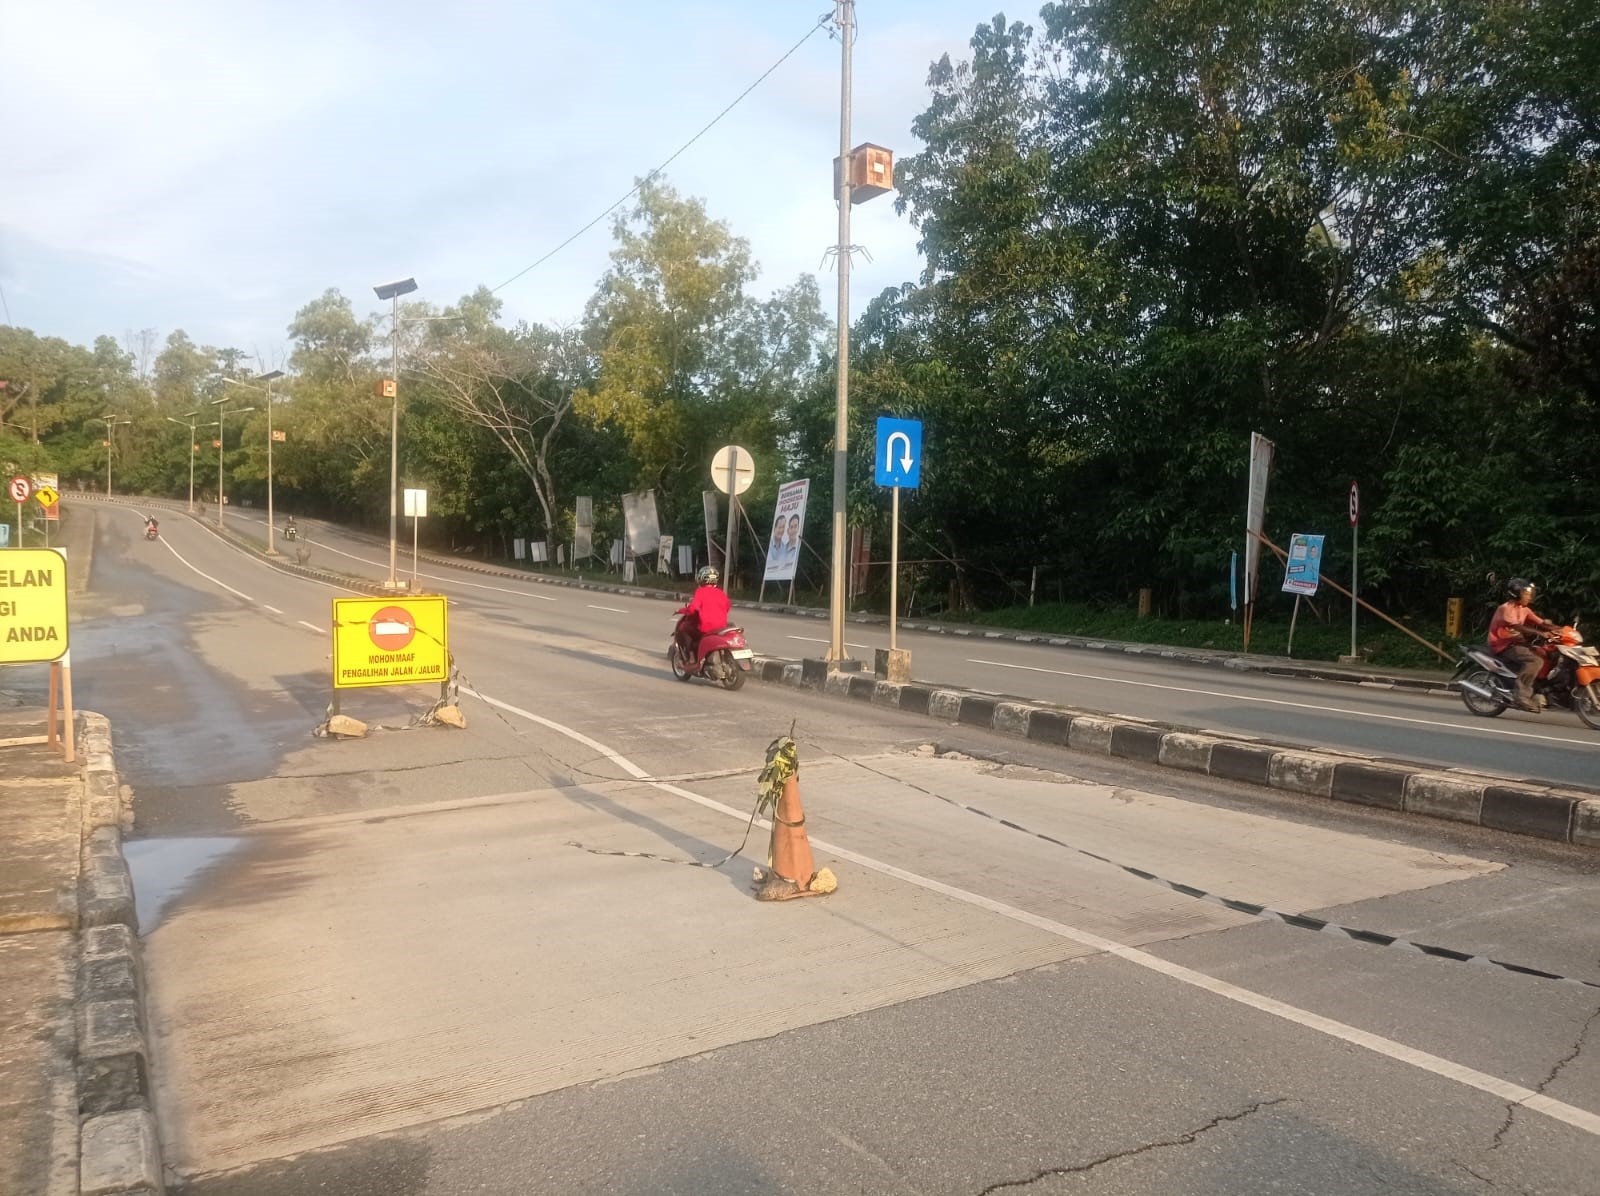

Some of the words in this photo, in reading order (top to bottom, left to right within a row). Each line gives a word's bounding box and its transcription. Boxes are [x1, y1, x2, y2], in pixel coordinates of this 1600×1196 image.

[0, 570, 52, 587] ELAN
[6, 626, 58, 642] ANDA
[369, 655, 395, 664] MOHON
[396, 653, 415, 662] MAAF
[342, 667, 388, 678] PENGALIHAN
[390, 666, 413, 676] JALAN
[418, 664, 440, 674] JALUR
